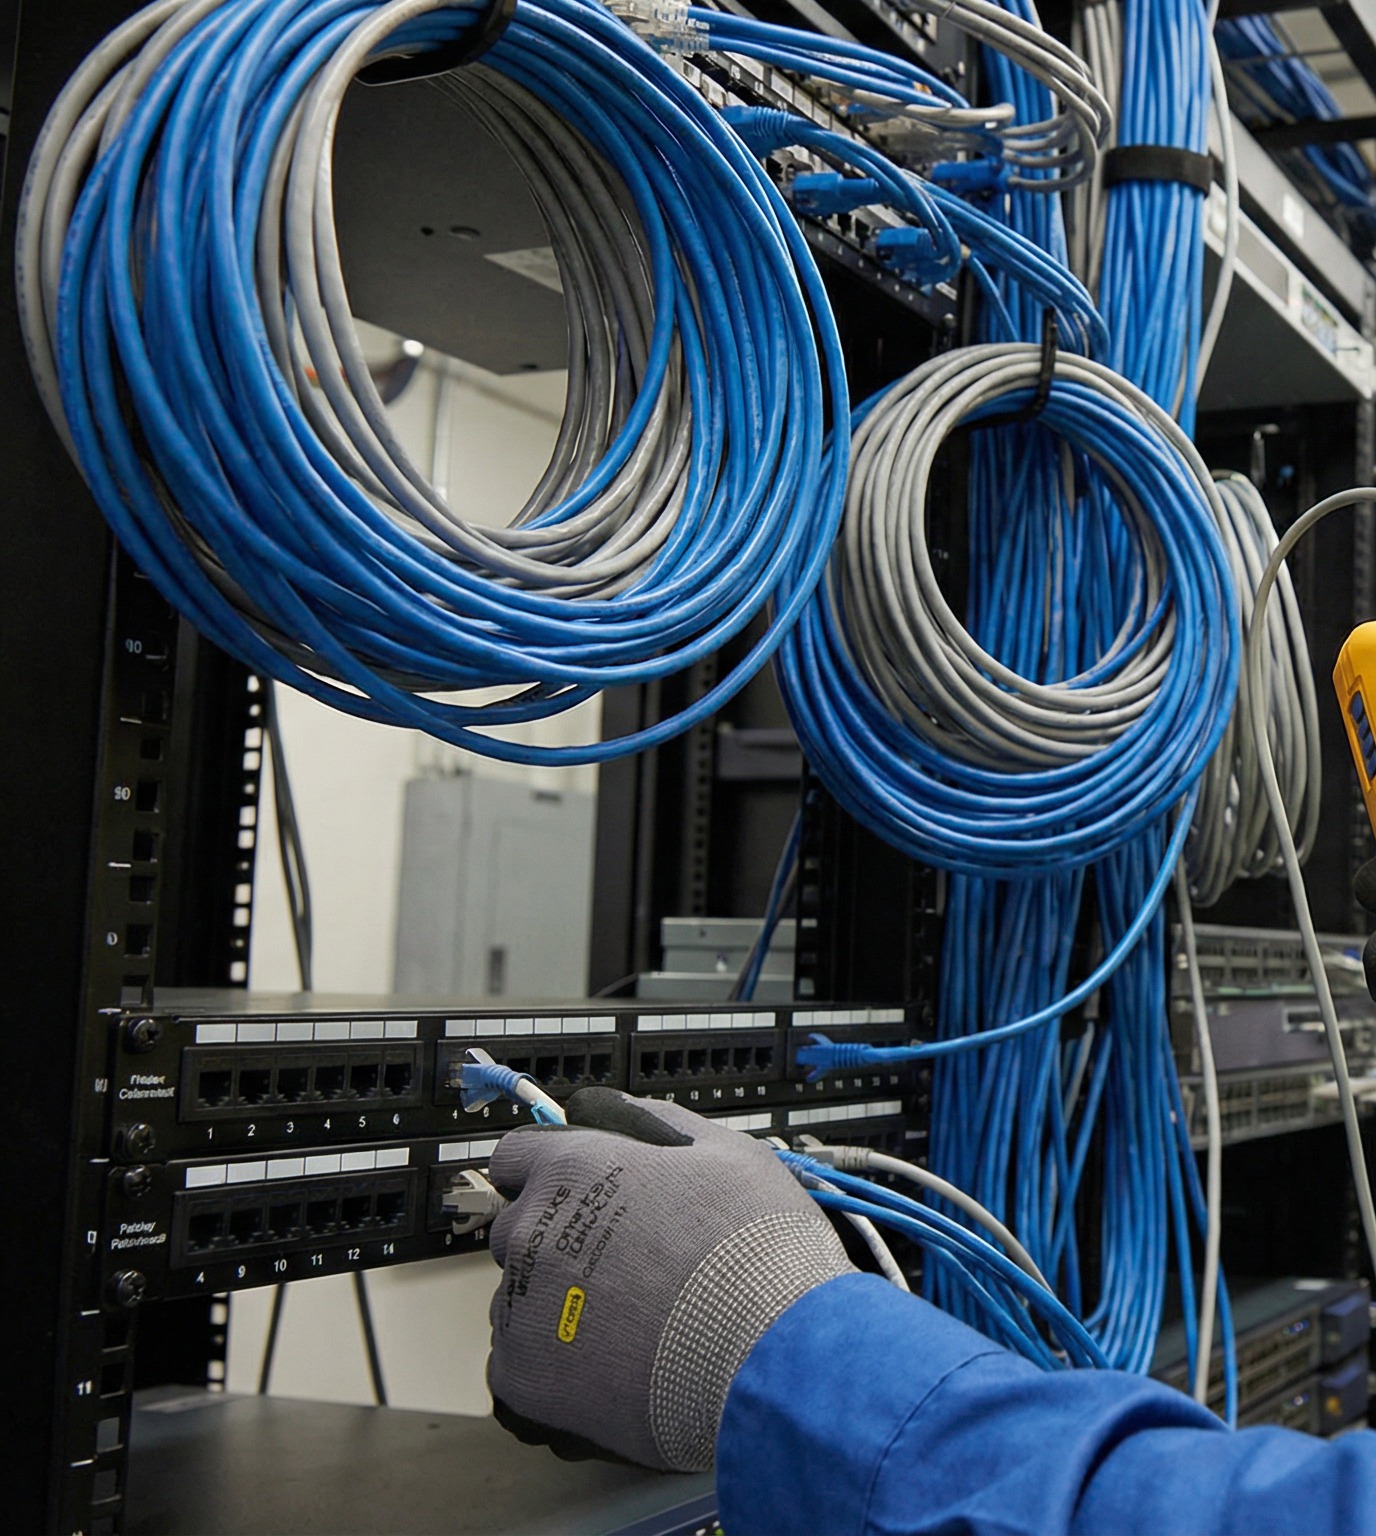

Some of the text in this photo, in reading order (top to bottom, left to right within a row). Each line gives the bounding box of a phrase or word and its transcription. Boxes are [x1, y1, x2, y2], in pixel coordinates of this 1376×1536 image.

[207, 1113, 400, 1140] 1 2 3 4 5 6
[238, 1265, 246, 1278] 9
[274, 1258, 288, 1272] 10
[311, 1253, 323, 1266] 11
[347, 1248, 360, 1260] 12
